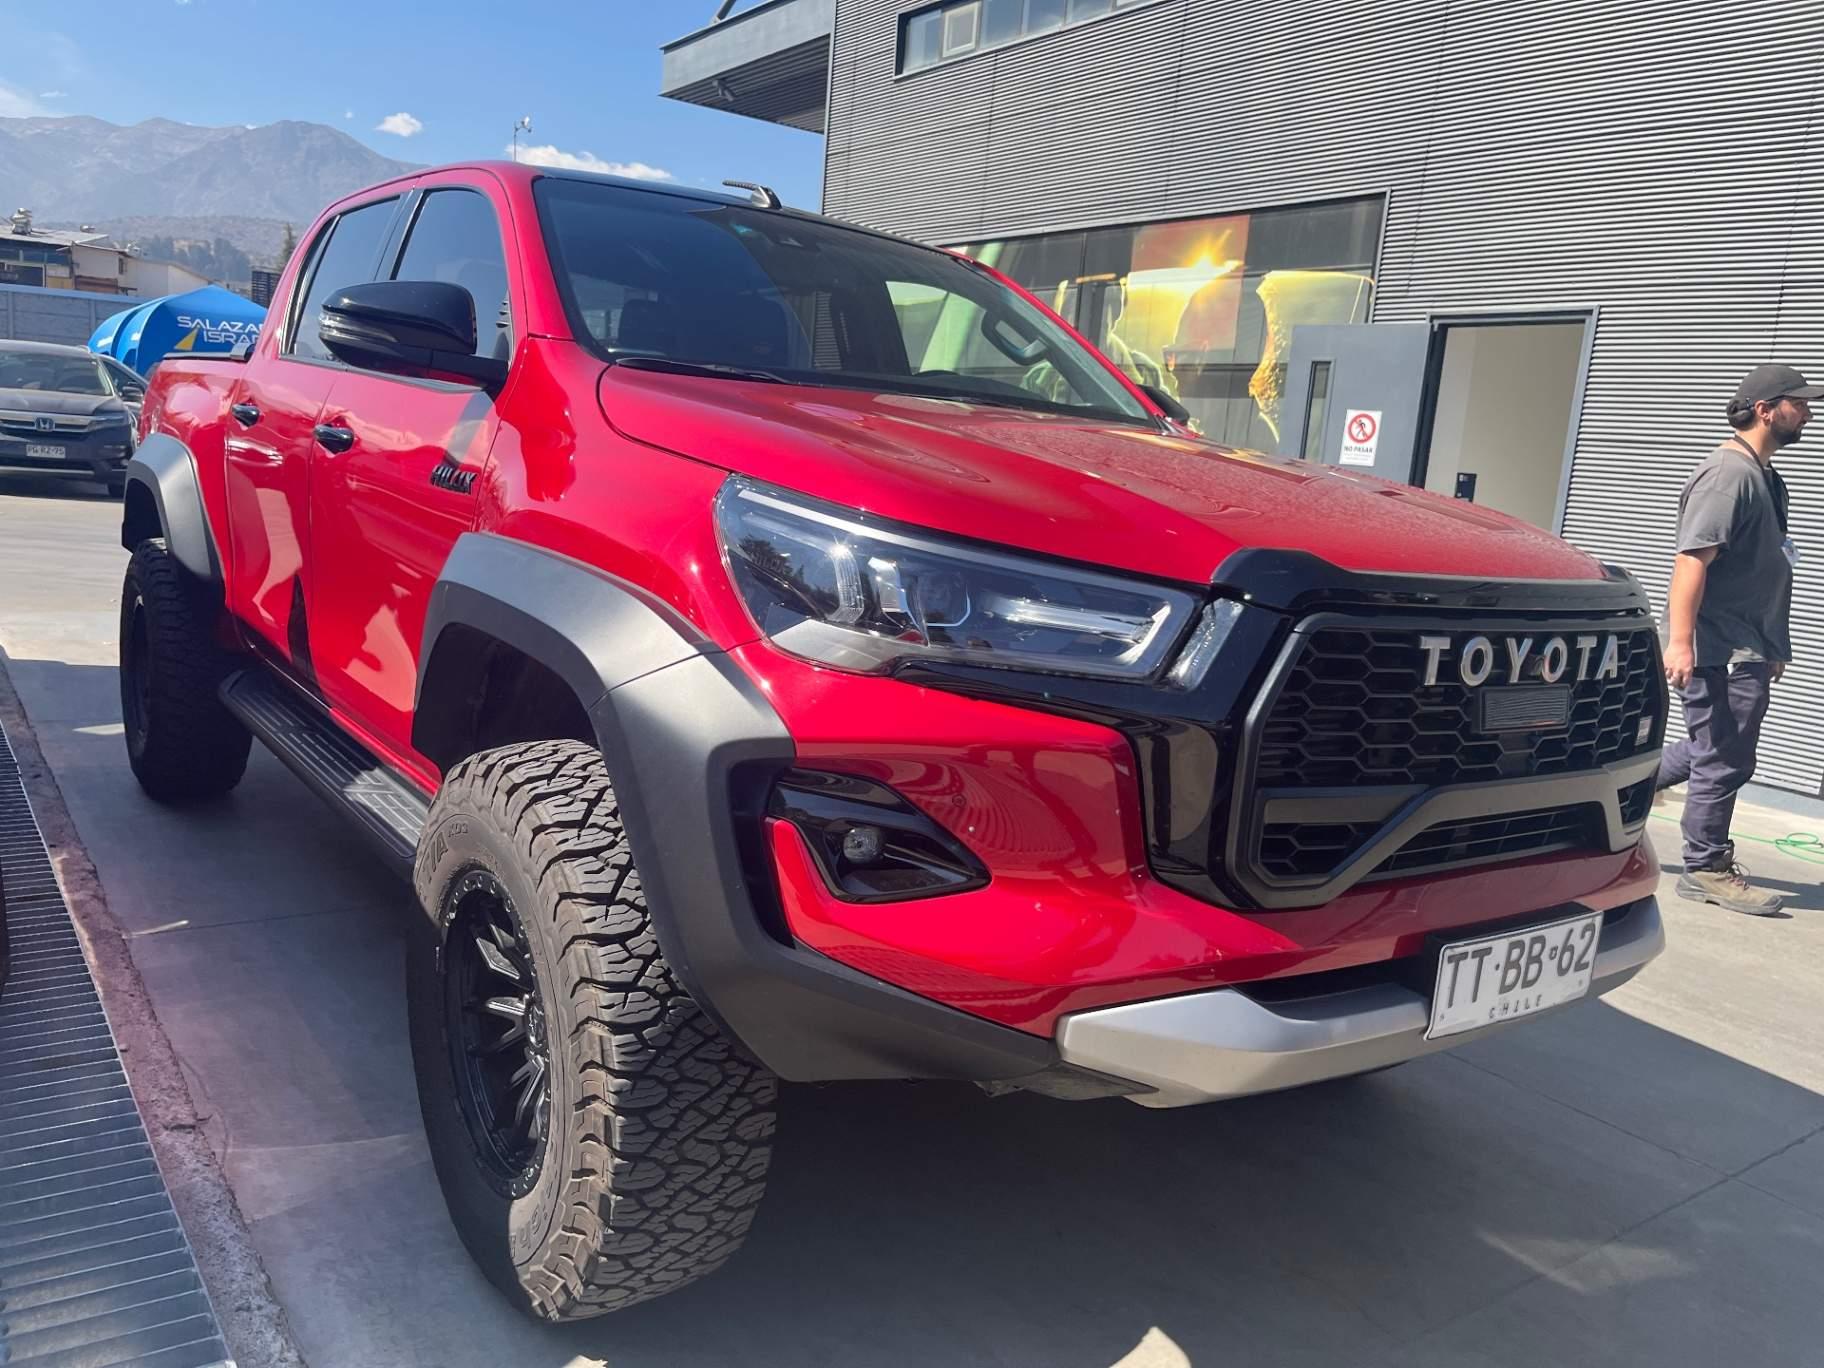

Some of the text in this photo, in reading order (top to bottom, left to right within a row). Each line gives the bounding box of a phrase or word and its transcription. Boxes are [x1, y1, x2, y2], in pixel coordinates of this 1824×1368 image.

[431, 464, 477, 495] HILUX
[1420, 635, 1618, 687] TOYOTA
[1488, 994, 1543, 1019] CHILE
